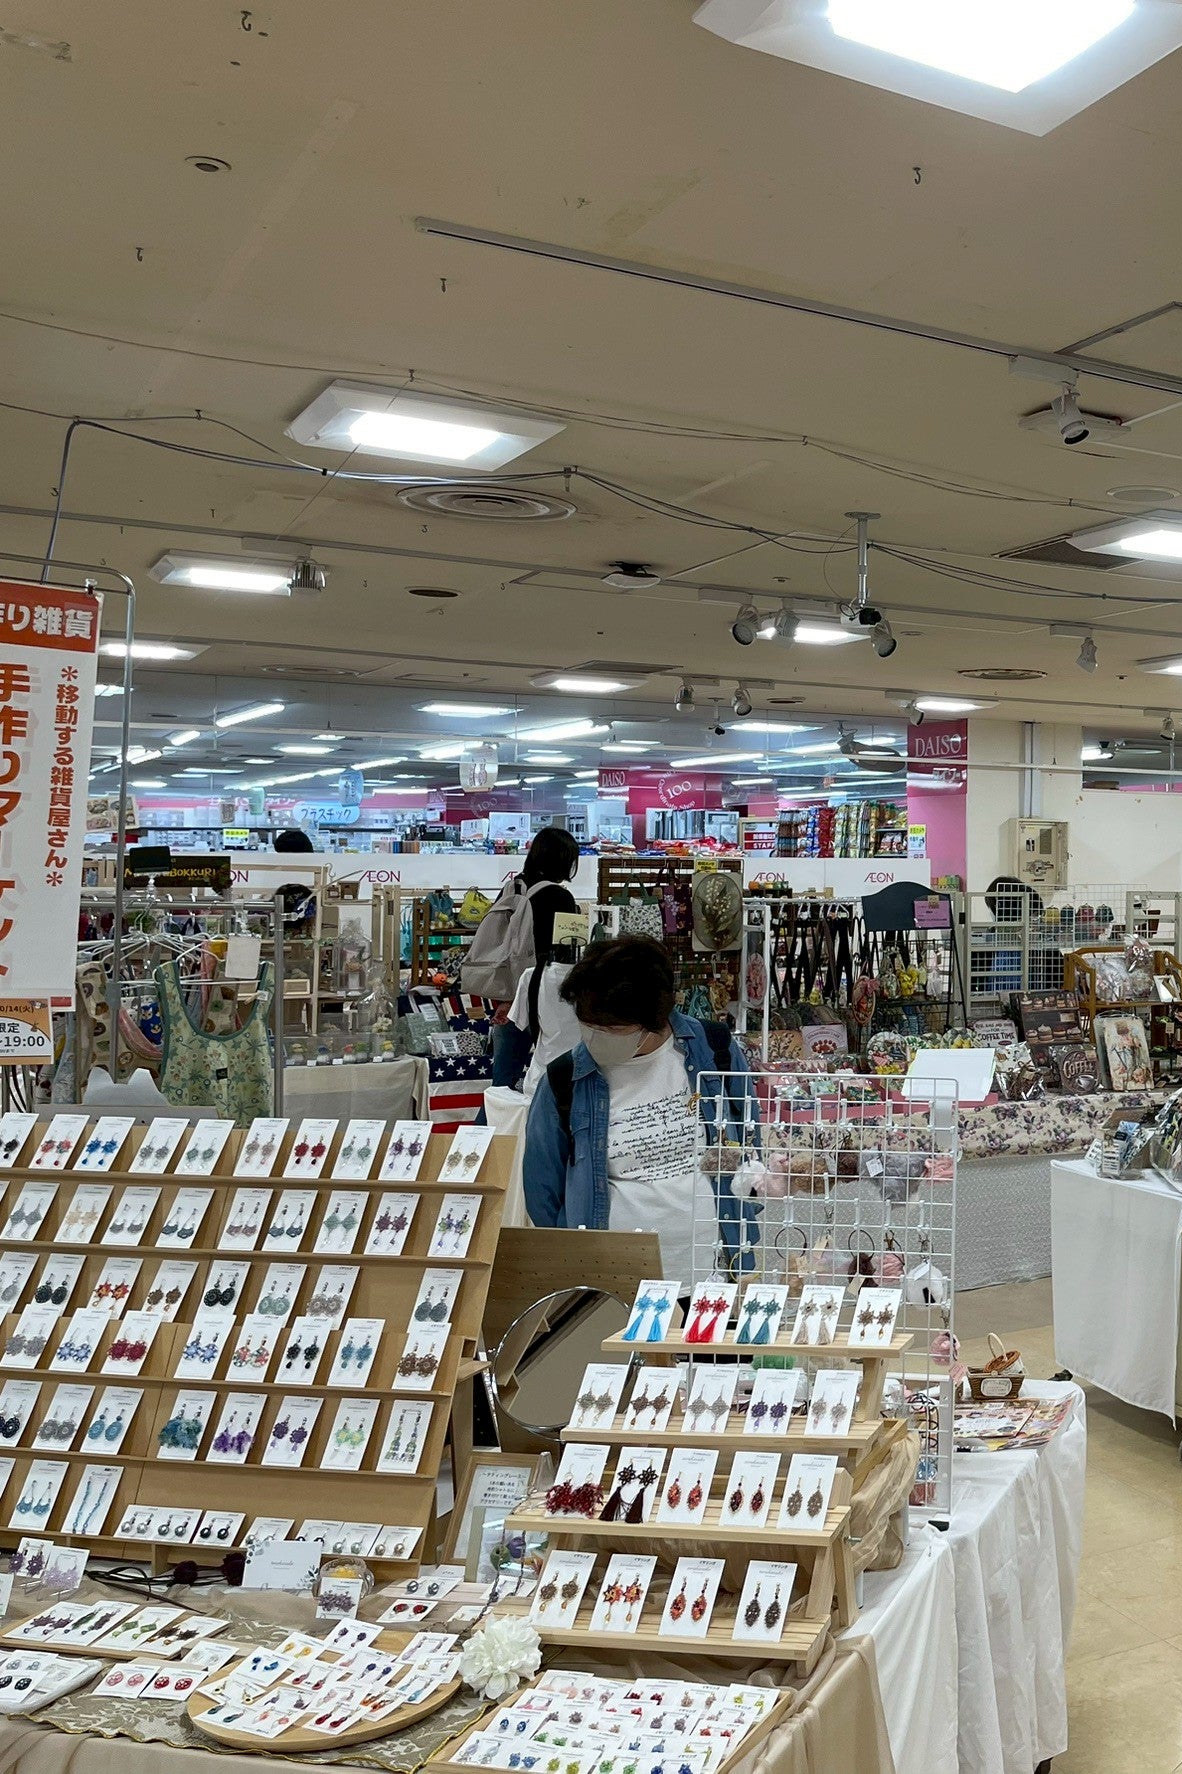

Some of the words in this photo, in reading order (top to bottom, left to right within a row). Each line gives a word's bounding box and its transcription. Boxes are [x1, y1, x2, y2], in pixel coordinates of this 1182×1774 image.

[0, 603, 94, 640] り雑貨
[915, 734, 961, 758] DAISO
[602, 771, 625, 787] DAISO
[667, 780, 692, 799] 100
[230, 871, 249, 882] ON
[0, 1036, 45, 1047] 19:00
[978, 1032, 1000, 1041] COFFEE
[1000, 1031, 1015, 1040] TIME
